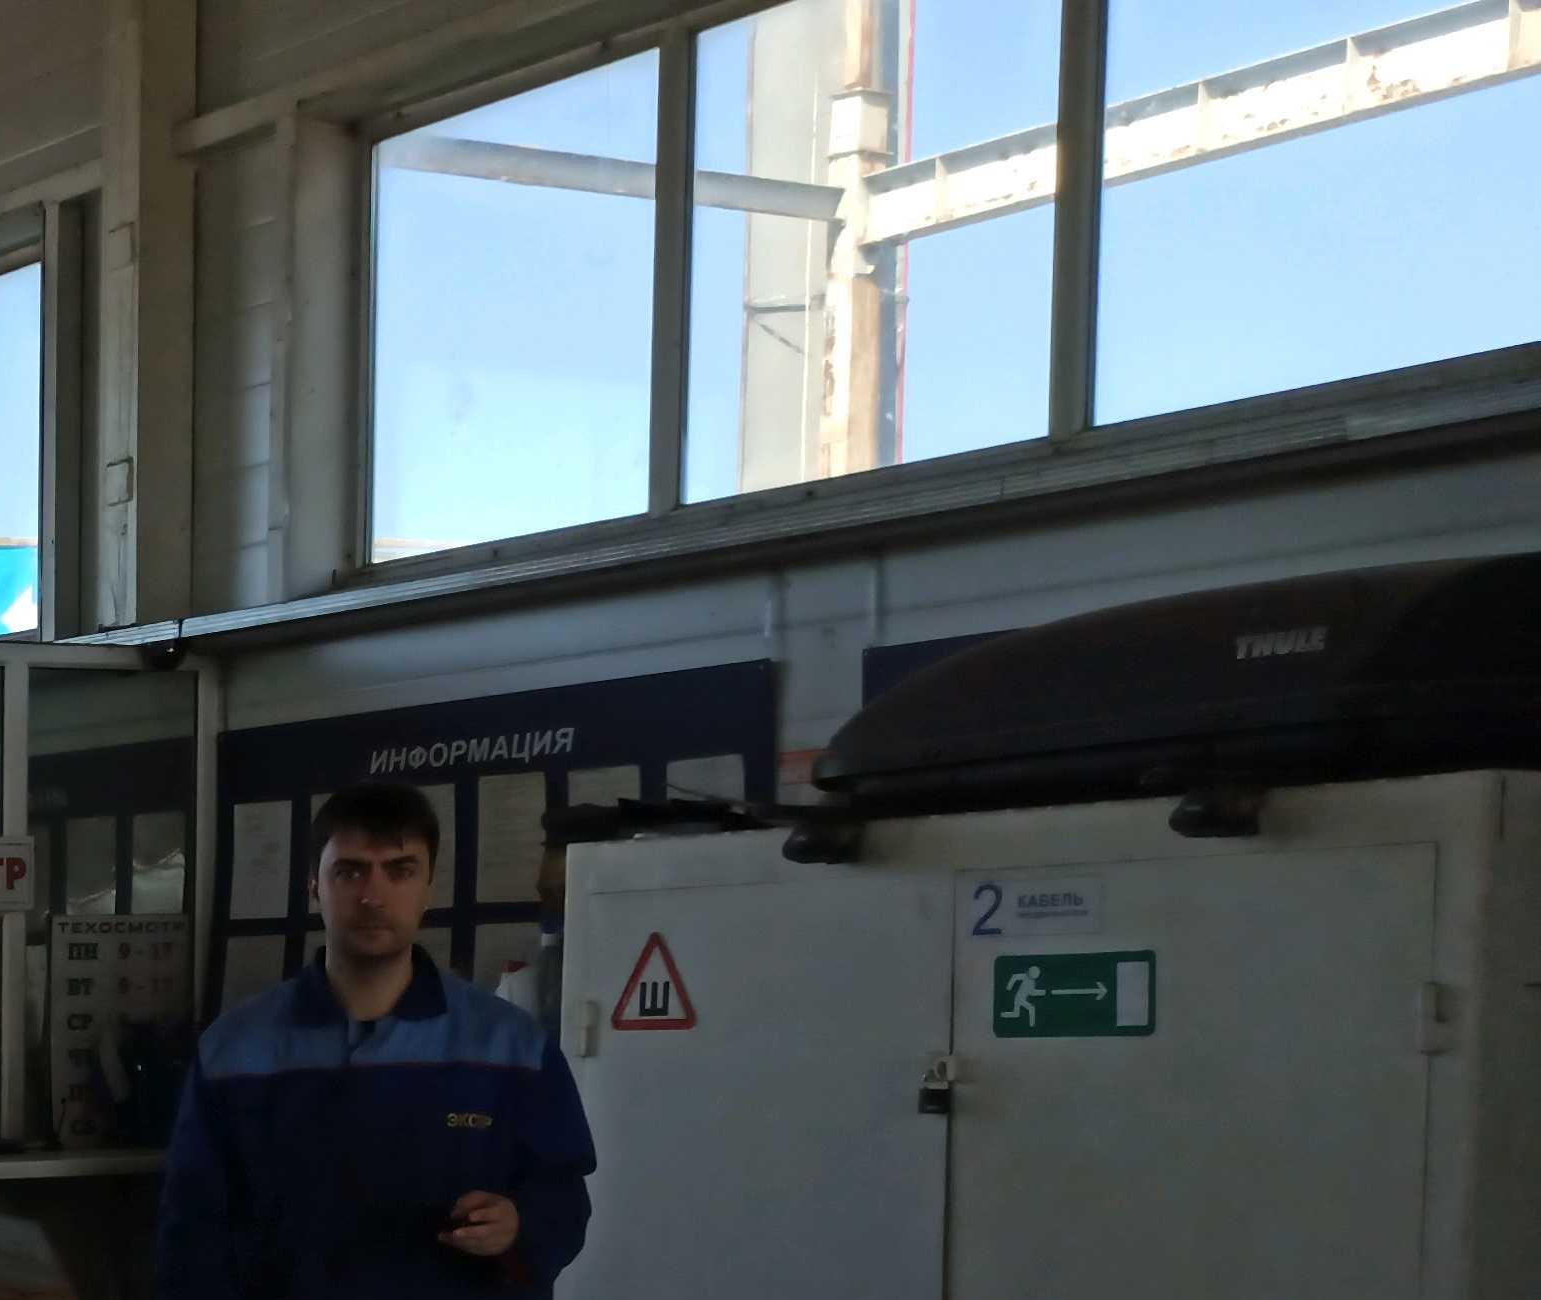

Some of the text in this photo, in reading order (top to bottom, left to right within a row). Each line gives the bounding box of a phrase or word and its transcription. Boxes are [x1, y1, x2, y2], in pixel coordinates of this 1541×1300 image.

[1234, 627, 1328, 660] THULE
[369, 727, 576, 775] ИНФОРМАЦИЯ
[973, 884, 1003, 935] 2
[640, 981, 670, 1016] Ш
